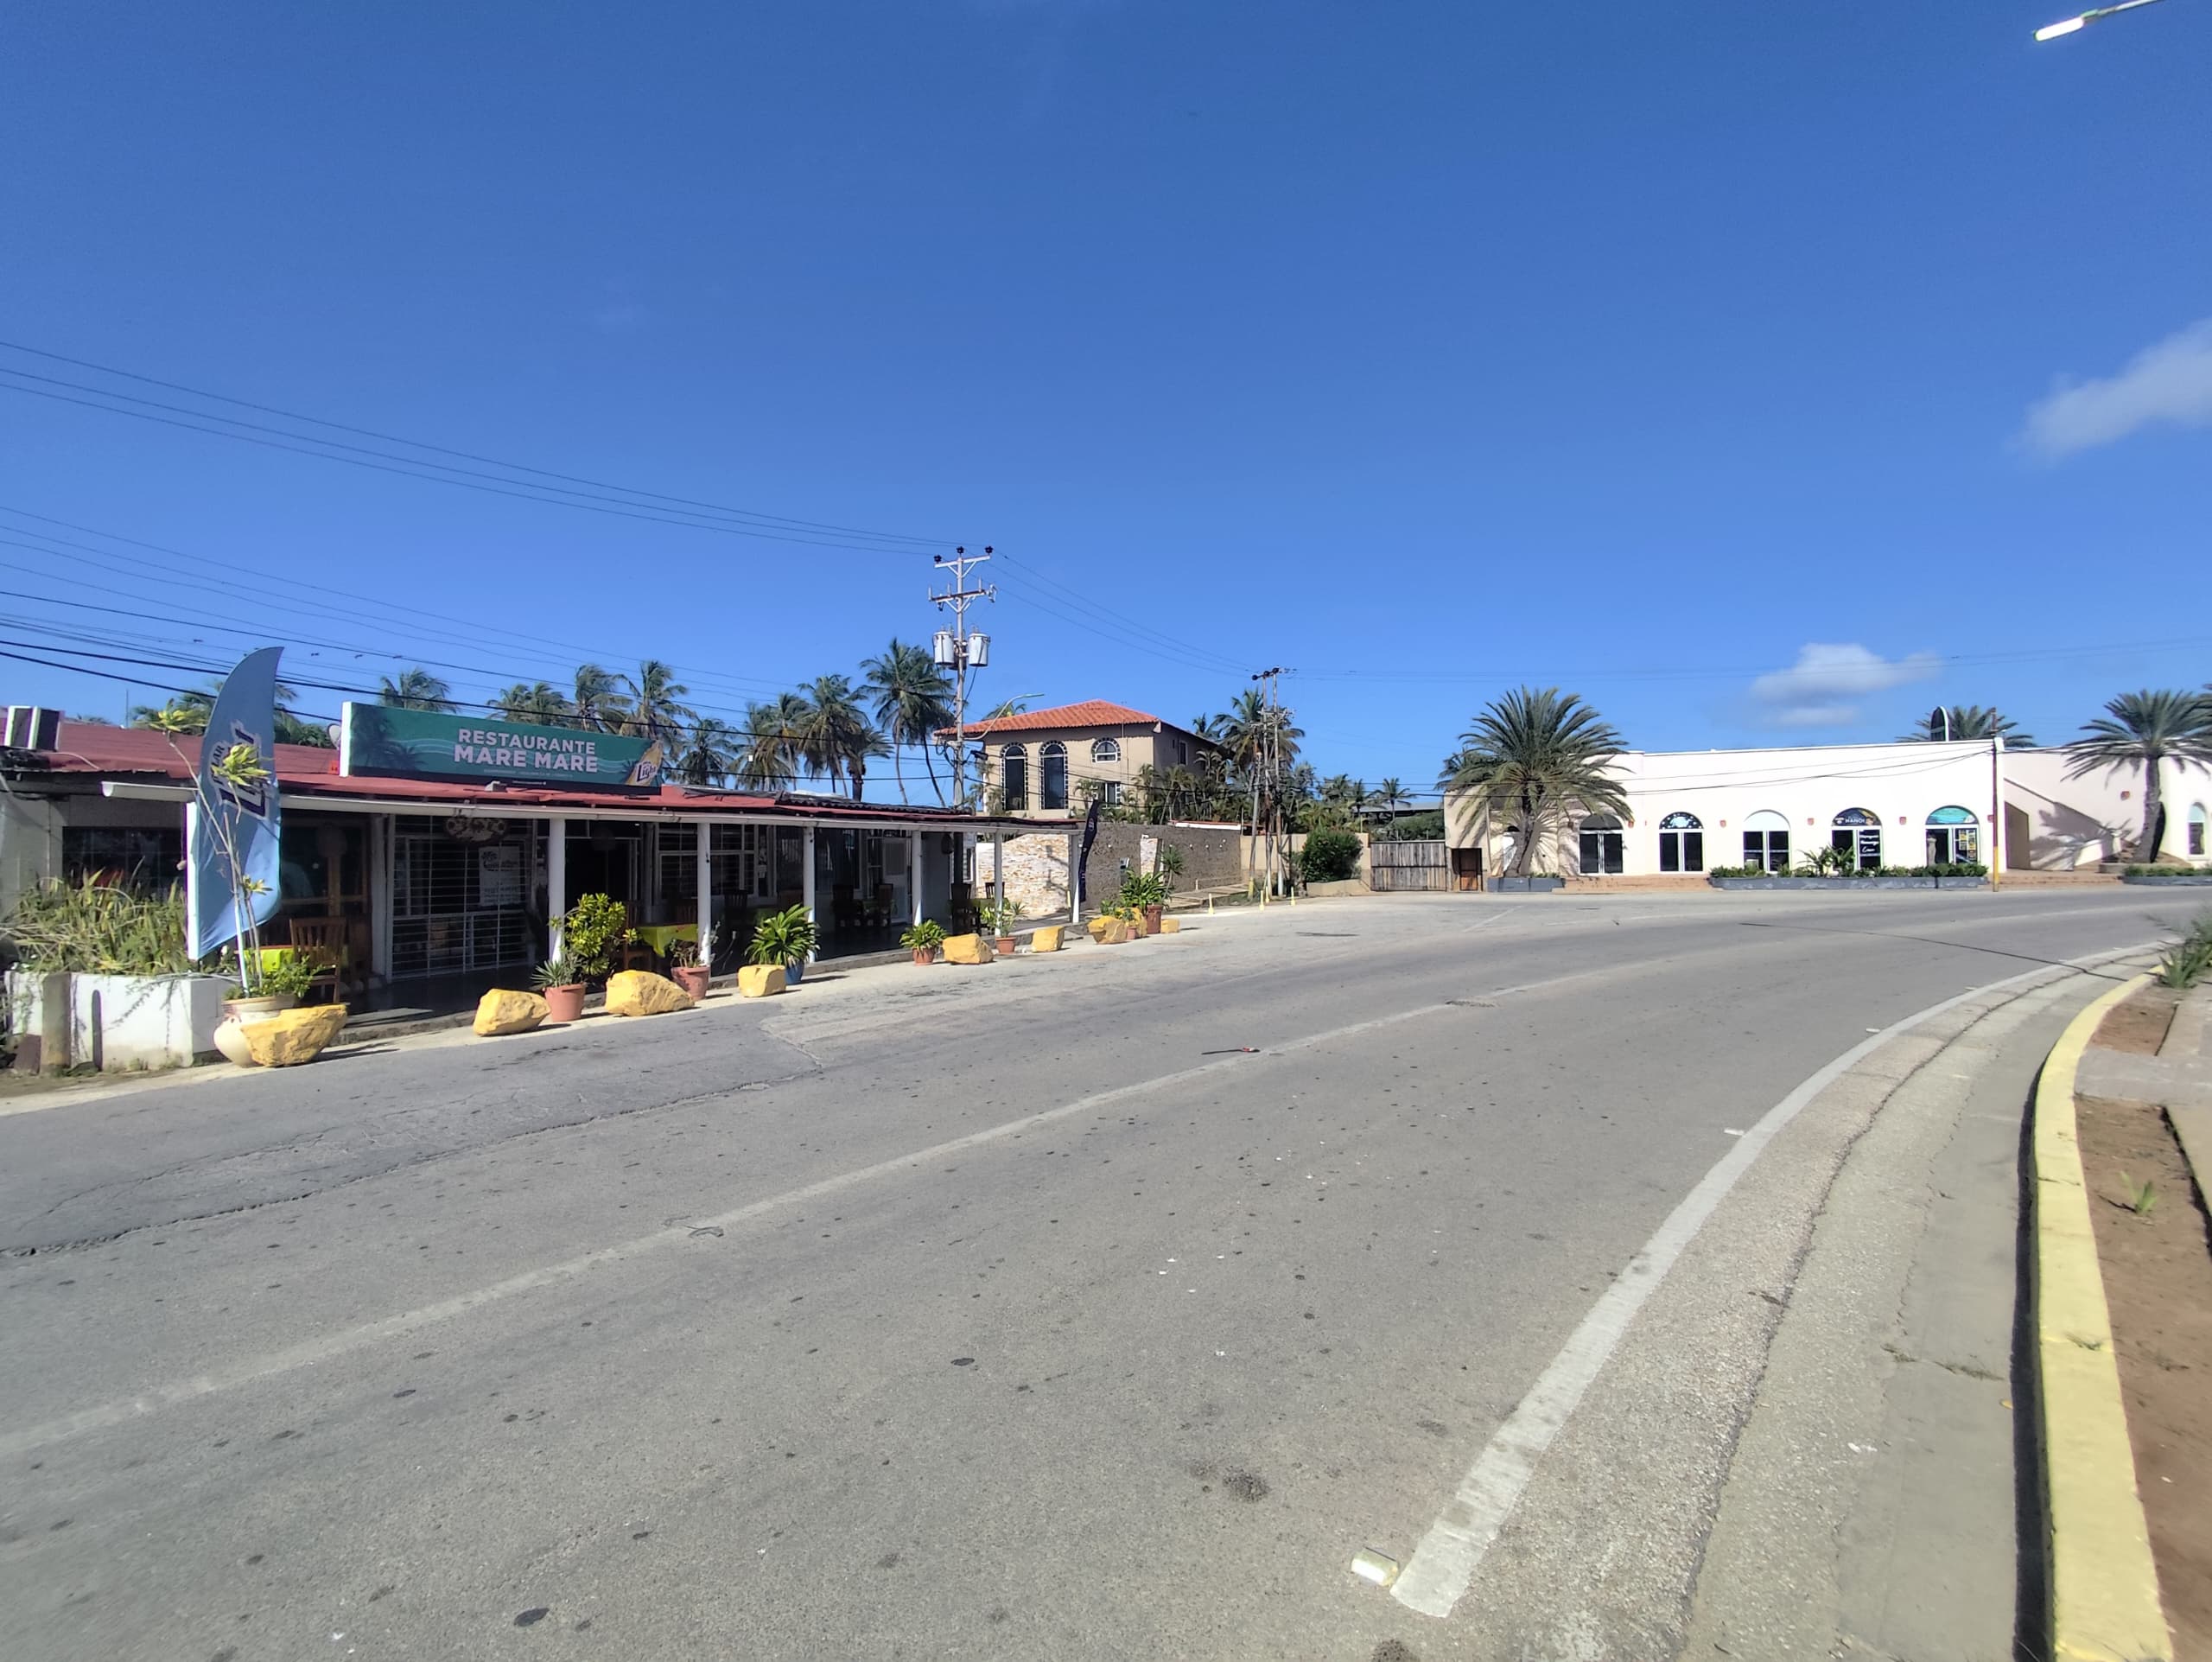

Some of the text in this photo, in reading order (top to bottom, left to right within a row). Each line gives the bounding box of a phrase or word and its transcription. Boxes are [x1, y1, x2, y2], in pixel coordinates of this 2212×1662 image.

[458, 729, 595, 755] RESTAURANTE
[454, 744, 598, 773] MARE MARE
